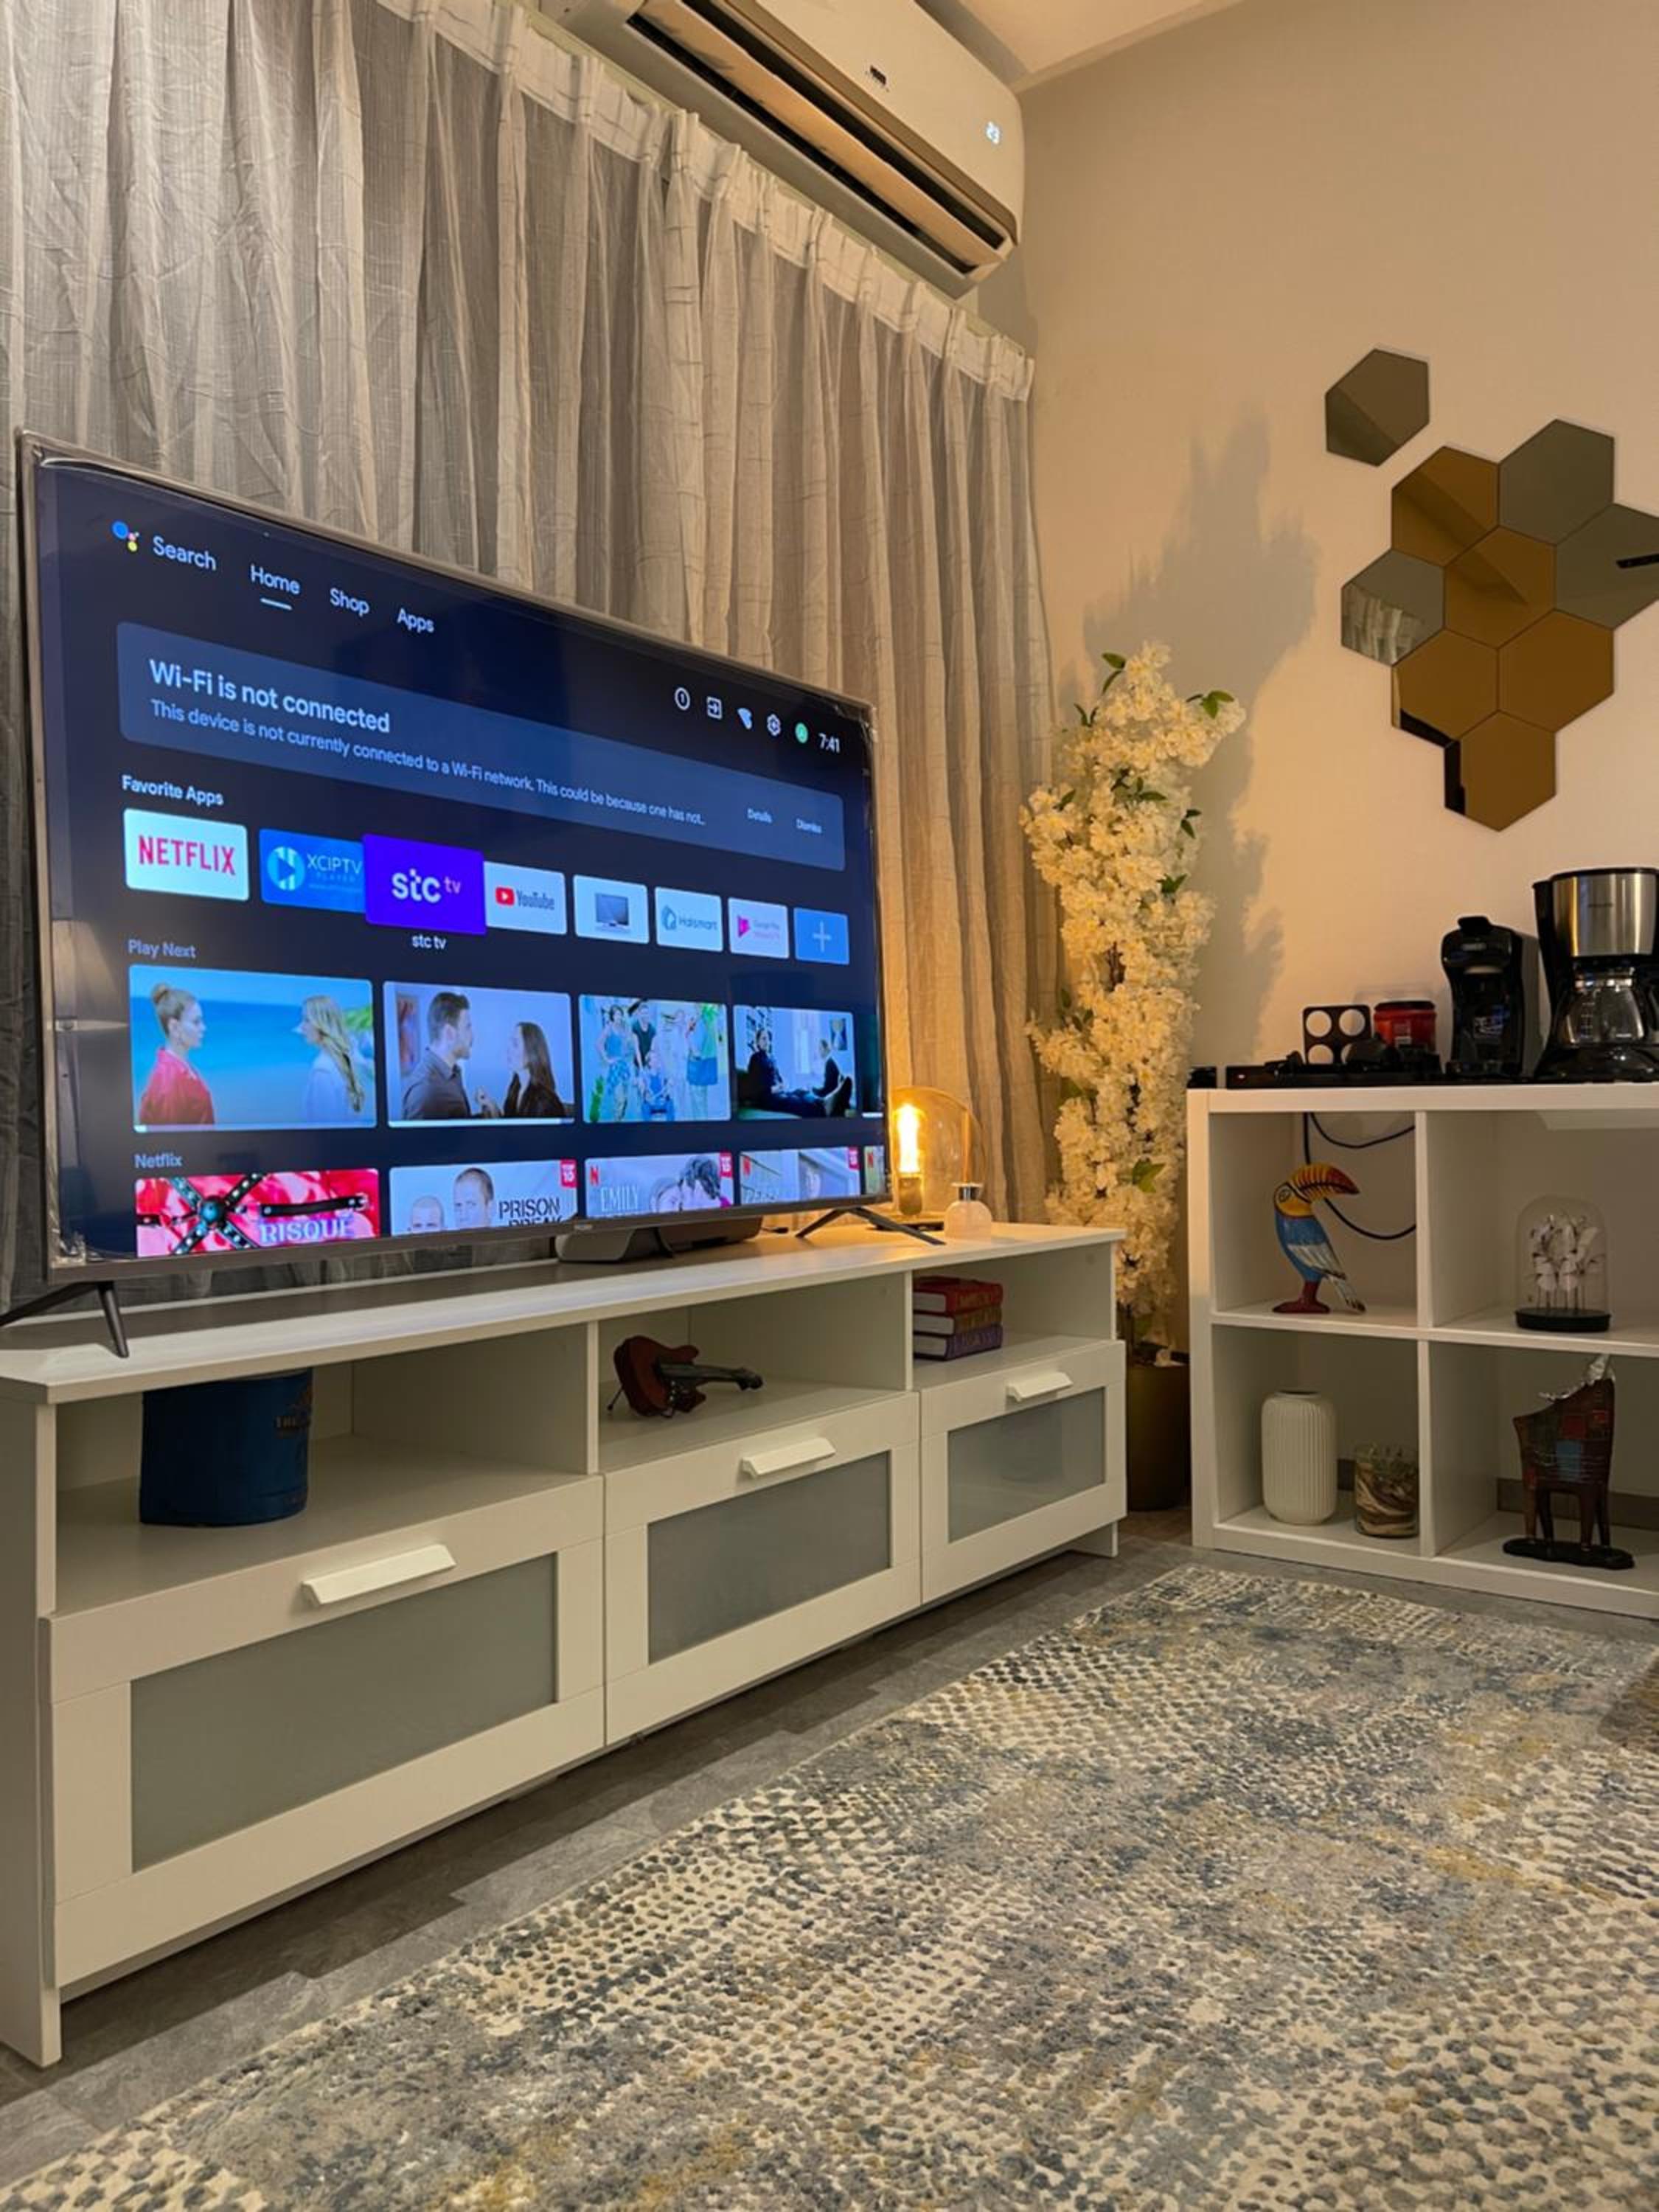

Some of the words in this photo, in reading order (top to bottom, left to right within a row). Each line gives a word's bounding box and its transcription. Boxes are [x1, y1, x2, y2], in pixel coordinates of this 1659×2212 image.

[153, 536, 217, 571] Search
[250, 565, 301, 594] Home
[330, 588, 369, 616] Shop
[397, 609, 434, 633] Apps
[150, 659, 212, 695] Wi-Fi
[218, 674, 237, 700] is
[242, 686, 279, 709] not
[282, 696, 390, 733] connected
[818, 732, 841, 754] 7:41
[151, 699, 184, 722] This
[188, 709, 240, 733] device
[243, 718, 256, 736] is
[259, 725, 285, 742] not
[287, 731, 350, 758] currently
[353, 744, 423, 769] connected
[426, 756, 439, 772] to
[442, 762, 450, 774] a
[451, 760, 482, 782] Wi-Fi
[484, 771, 534, 792] network.
[535, 778, 558, 796] This
[560, 786, 589, 802] could
[591, 790, 605, 805] be
[605, 793, 647, 814] because
[649, 804, 667, 818] one
[668, 806, 685, 822] has
[122, 774, 183, 801] Favorite
[186, 786, 225, 807] Apps
[137, 834, 236, 876] NETFLIX
[307, 853, 363, 874] XCIPTV
[392, 868, 441, 903] stc
[444, 876, 462, 894] tv
[516, 888, 555, 911] YouTube
[128, 939, 159, 959] Play
[162, 941, 197, 959] Next
[411, 933, 432, 950] stc
[434, 935, 447, 950] tv
[134, 1152, 184, 1169] Netflix
[499, 1197, 560, 1220] PRISON
[601, 1185, 639, 1213] EMILY
